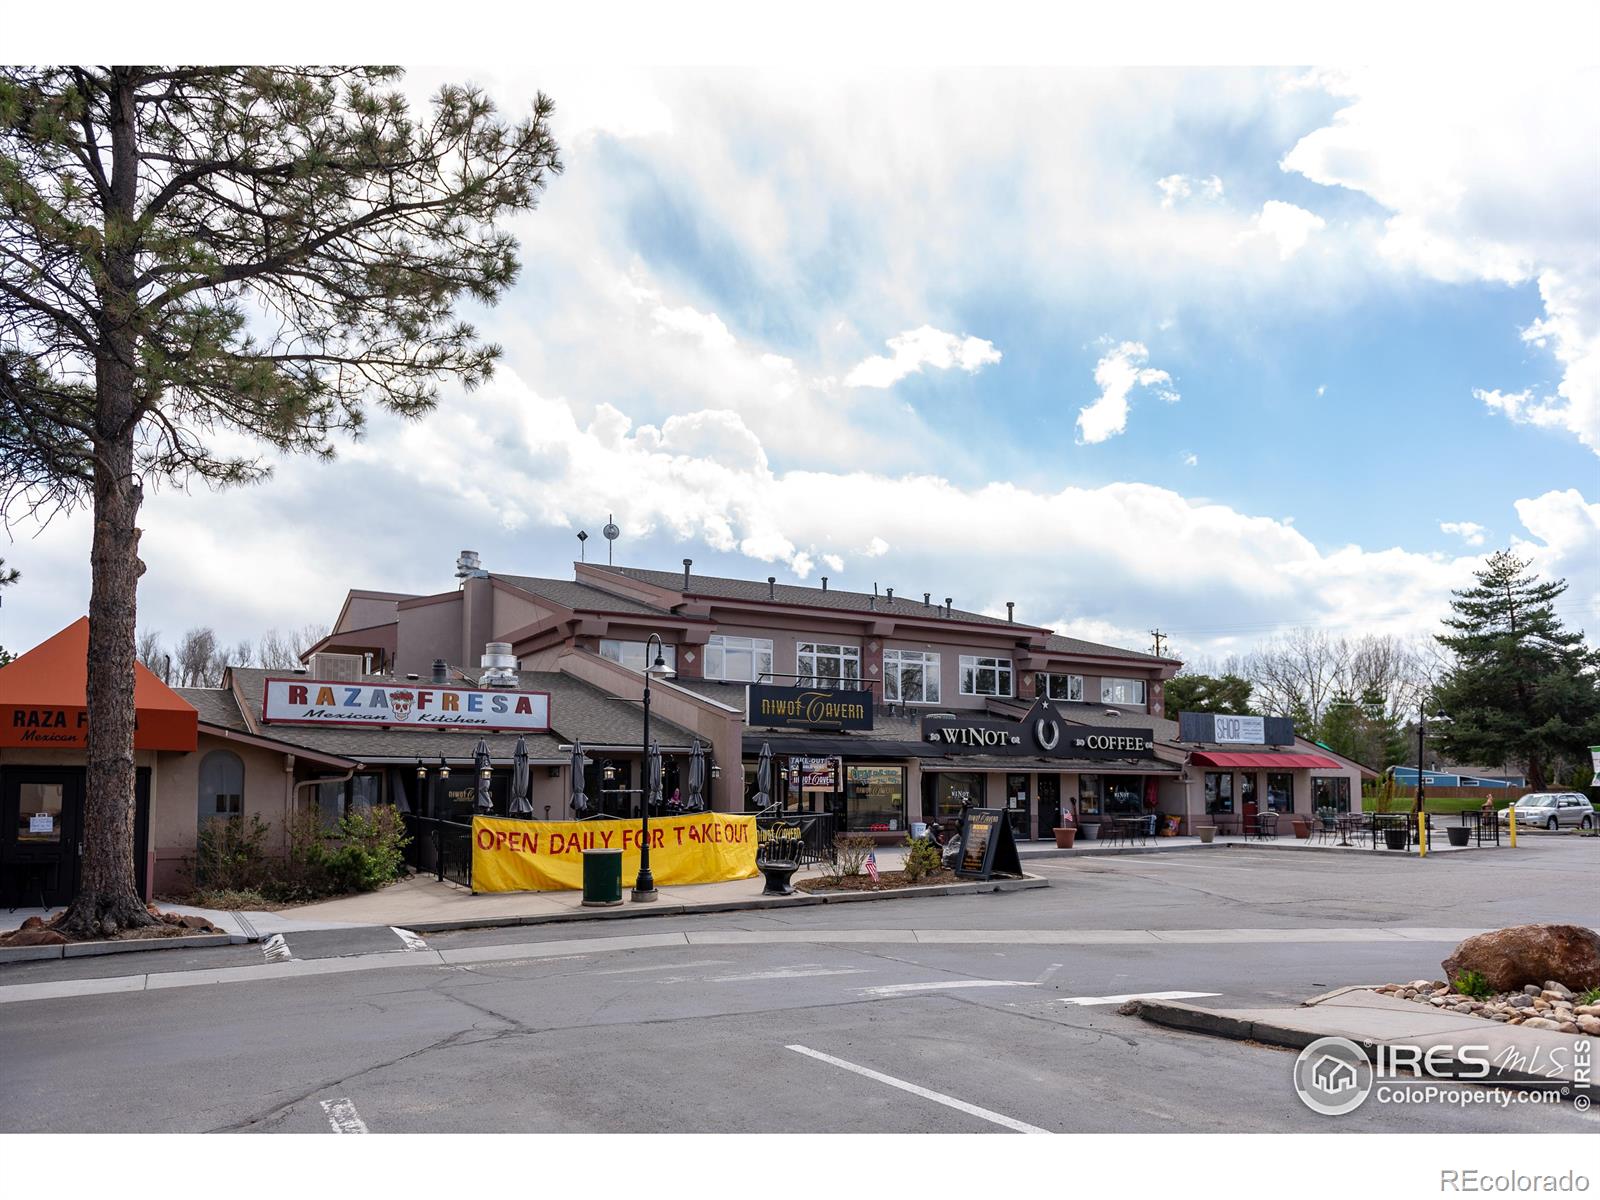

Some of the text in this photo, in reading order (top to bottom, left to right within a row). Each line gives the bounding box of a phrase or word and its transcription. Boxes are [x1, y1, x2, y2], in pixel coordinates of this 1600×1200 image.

[289, 685, 533, 714] RAZA FRESA
[13, 710, 66, 728] RAZA
[302, 709, 488, 724] Mexican Kitchen
[20, 729, 77, 742] Mexican
[942, 727, 1009, 746] WINOT
[1087, 735, 1144, 751] COFFEE
[477, 823, 748, 855] OPEN DAILY FOR TAKE OUT
